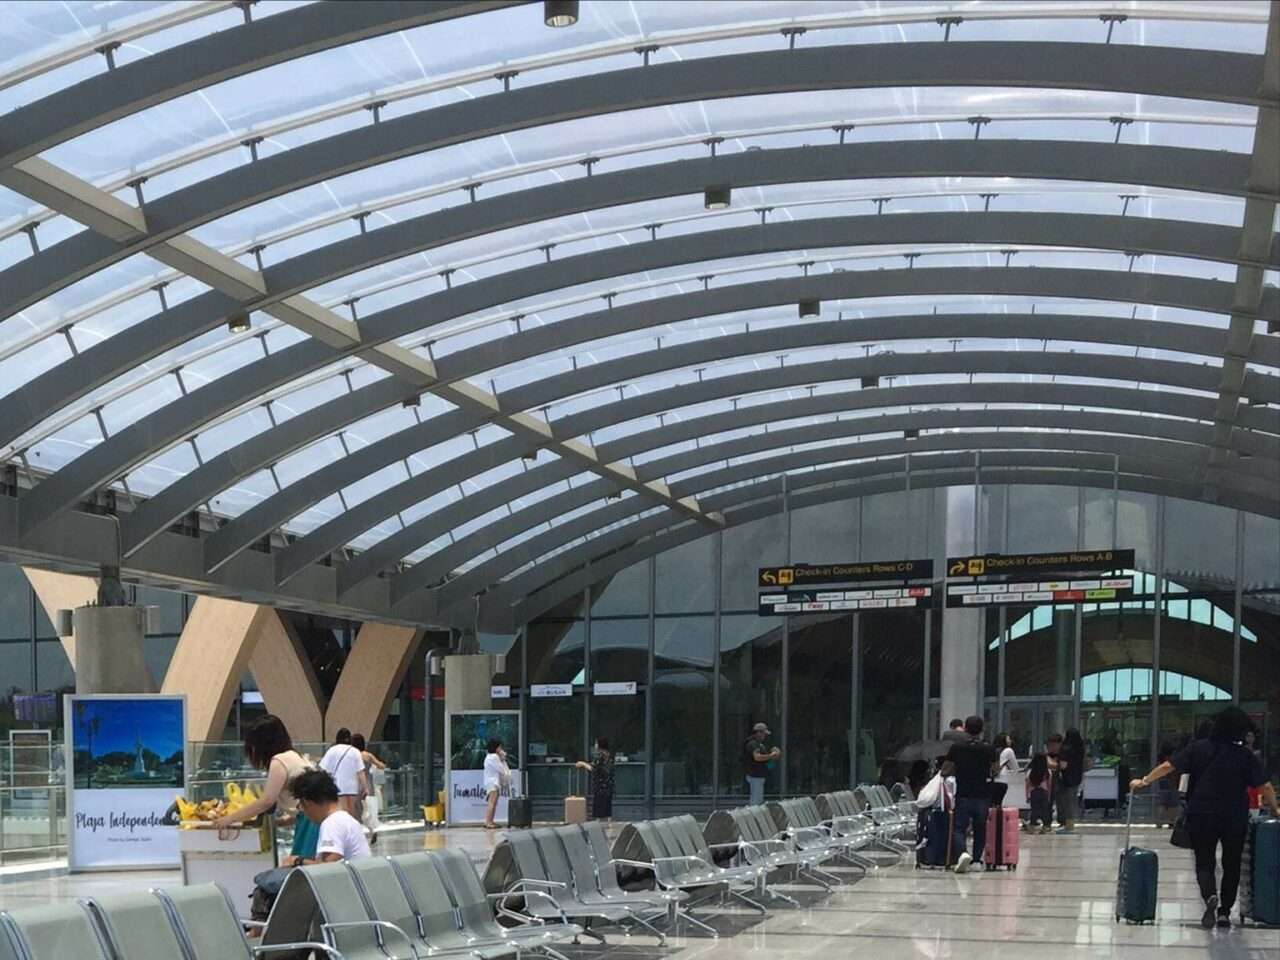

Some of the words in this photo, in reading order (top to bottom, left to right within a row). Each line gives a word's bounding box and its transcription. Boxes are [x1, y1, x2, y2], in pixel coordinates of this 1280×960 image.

[1027, 555, 1068, 566] Counters
[1070, 553, 1095, 563] Rows
[833, 565, 870, 576] Counters
[873, 563, 896, 573] Rows
[109, 811, 163, 832] Independe
